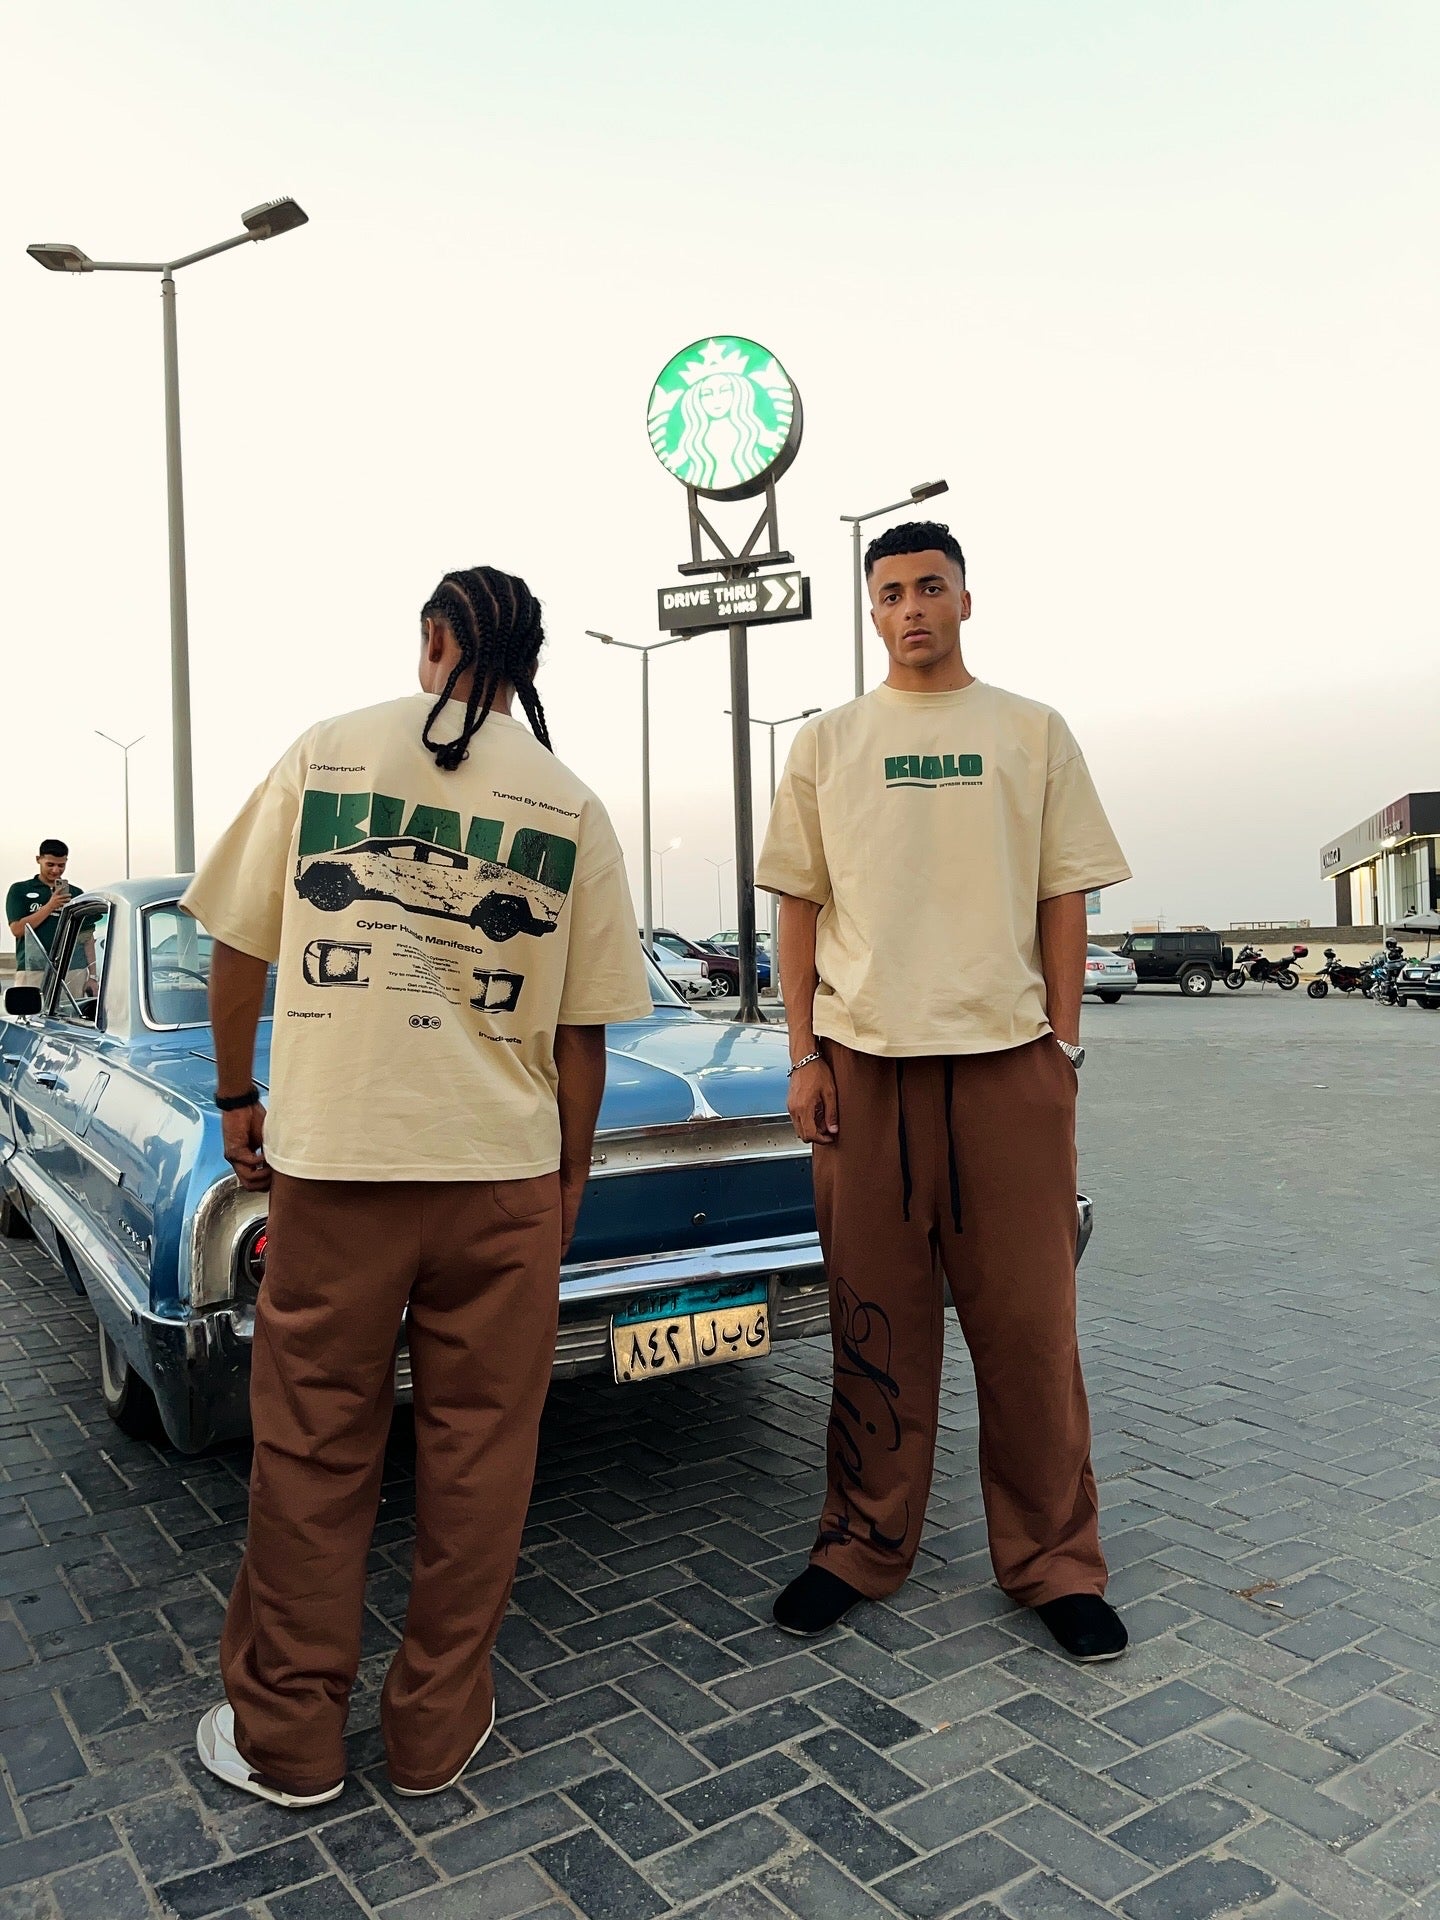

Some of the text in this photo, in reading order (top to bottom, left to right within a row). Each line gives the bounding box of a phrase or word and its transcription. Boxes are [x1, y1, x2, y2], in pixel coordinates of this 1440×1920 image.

[663, 583, 758, 610] DRIVE THRU
[718, 600, 758, 616] 24 HRS
[309, 763, 366, 772] Cybertruck
[884, 754, 983, 780] KIALO
[492, 790, 580, 819] Tuned By Mansory
[356, 920, 398, 930] Cyber
[425, 935, 483, 955] Manifesto
[287, 1010, 326, 1019] Chapter
